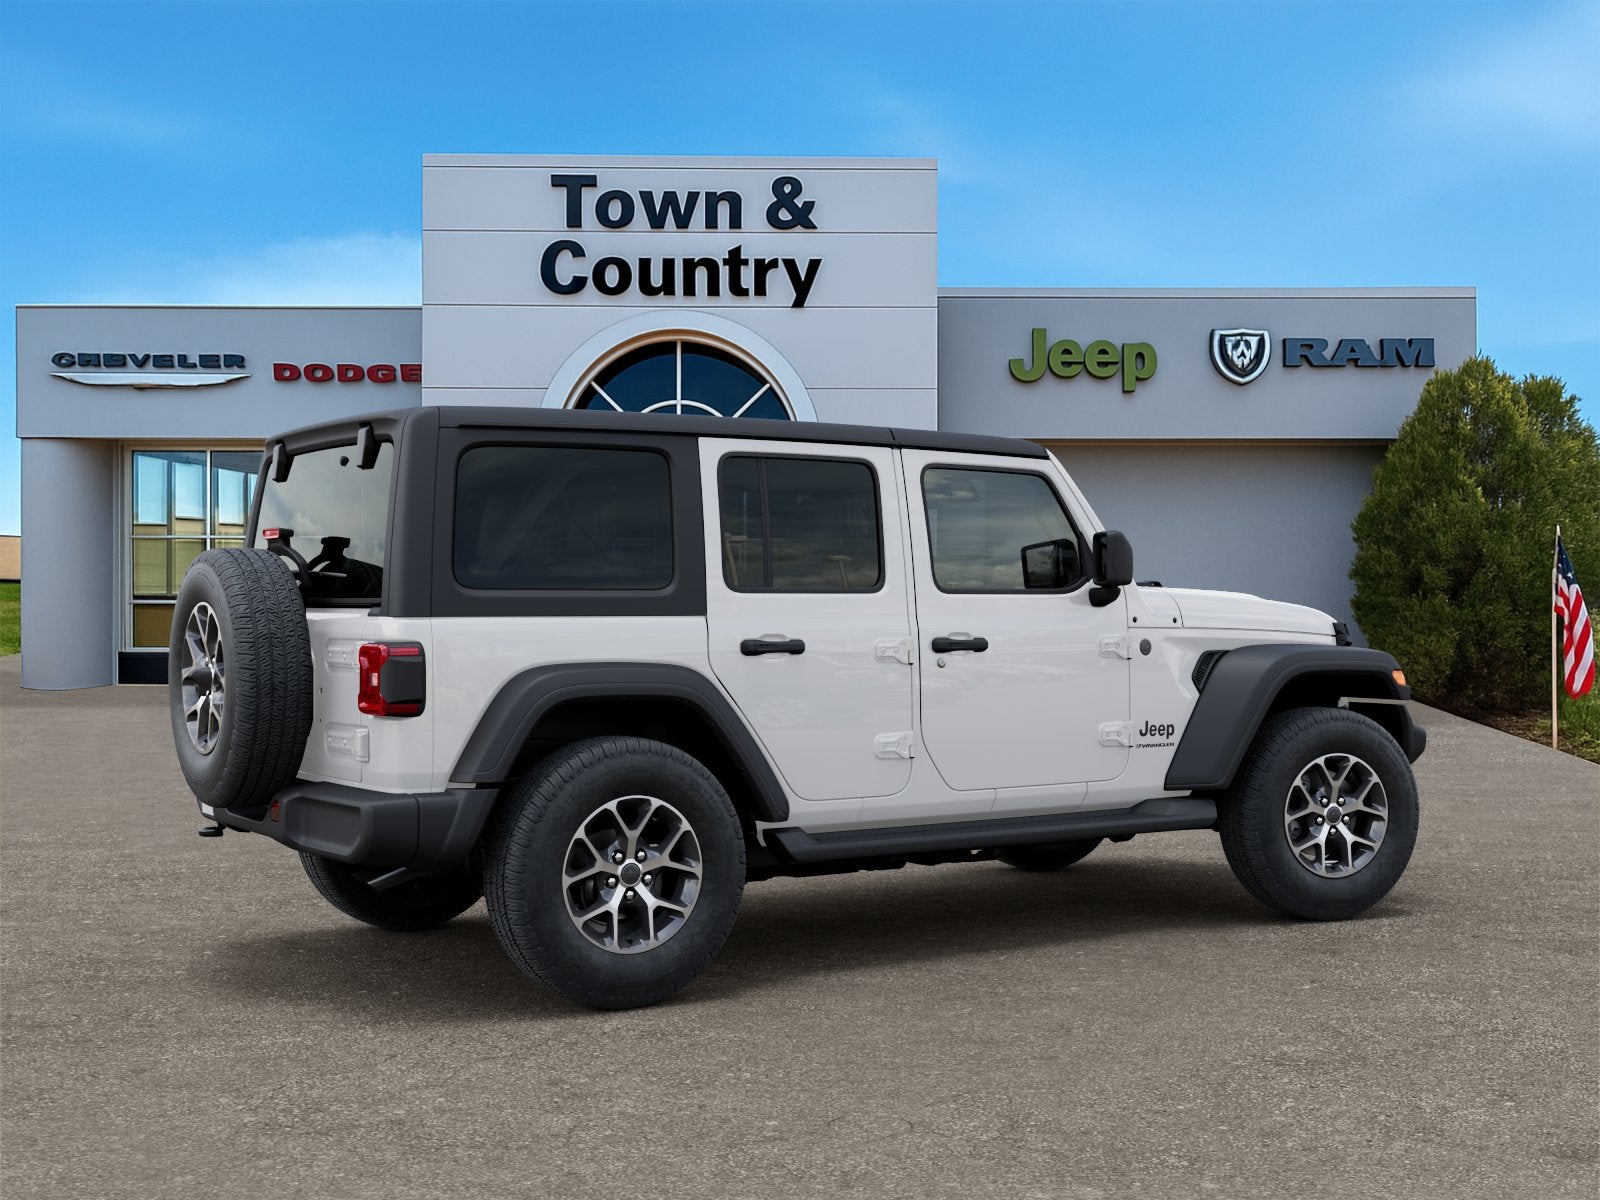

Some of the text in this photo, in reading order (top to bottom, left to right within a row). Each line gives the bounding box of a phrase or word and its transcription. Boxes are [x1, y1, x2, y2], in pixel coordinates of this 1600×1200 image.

[550, 174, 818, 230] Town &
[540, 239, 822, 308] Country
[273, 363, 422, 383] DODGE
[1009, 328, 1157, 393] Jeep
[1283, 337, 1435, 368] RAM
[1139, 720, 1175, 739] Jeep
